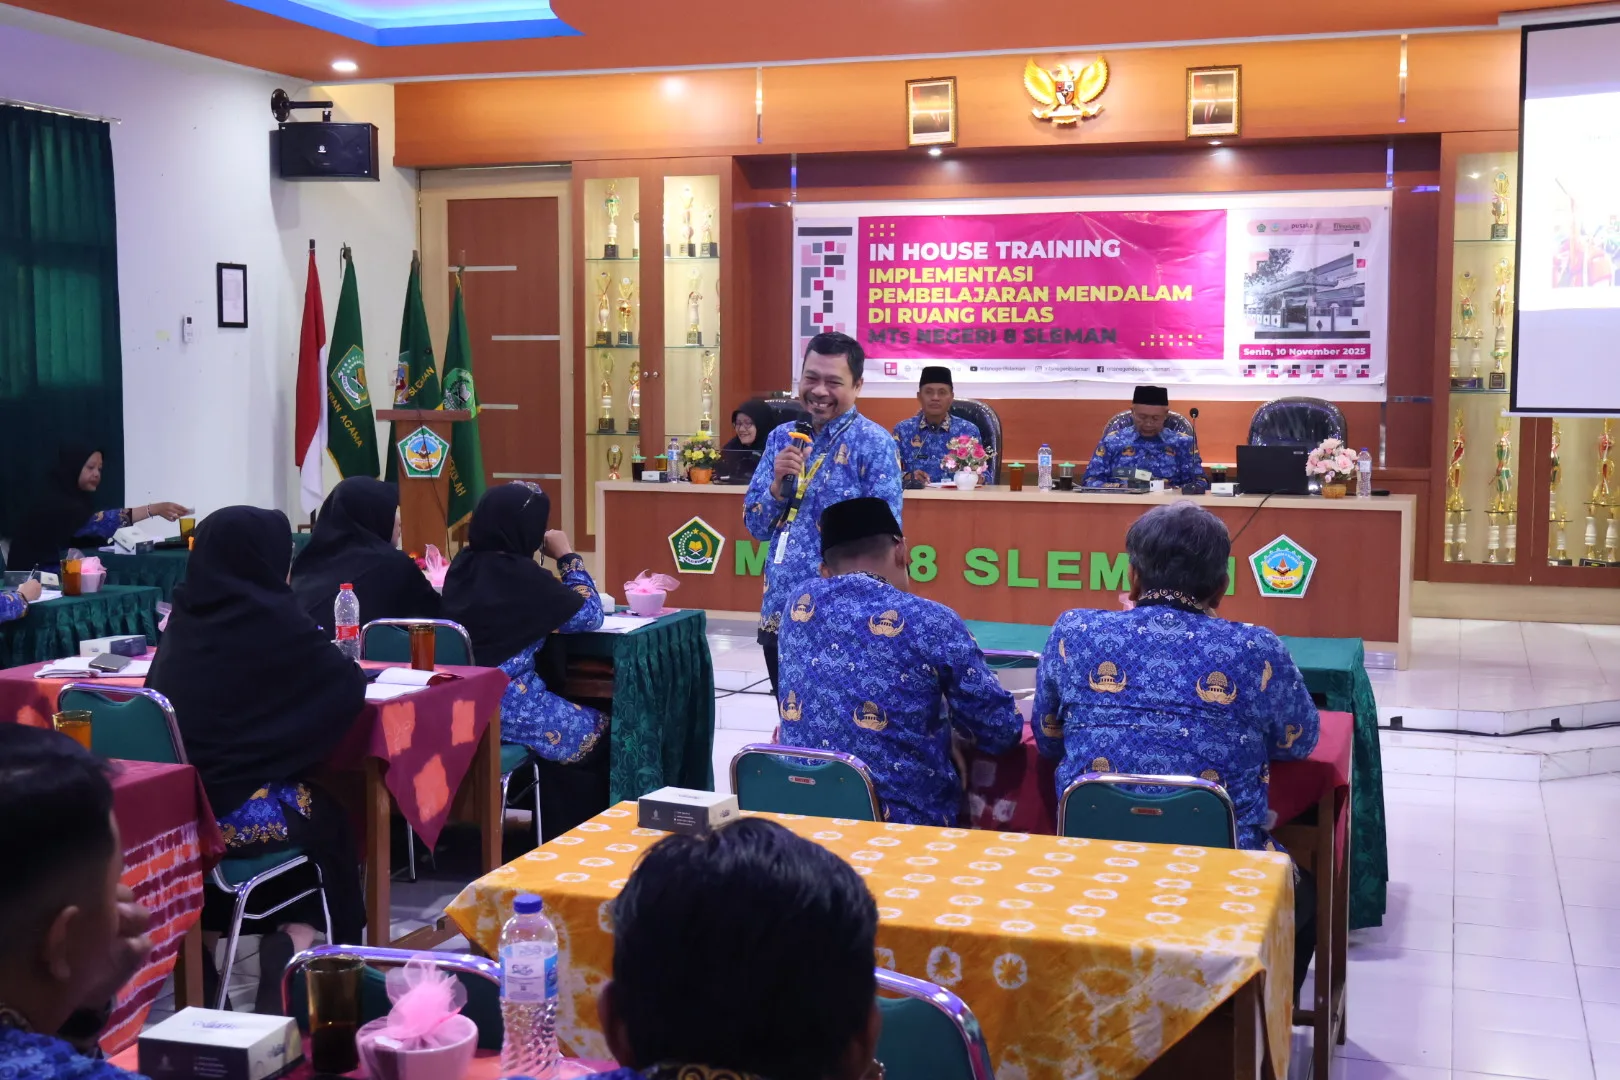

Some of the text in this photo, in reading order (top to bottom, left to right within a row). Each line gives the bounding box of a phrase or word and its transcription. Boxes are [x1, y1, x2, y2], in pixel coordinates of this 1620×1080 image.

[869, 239, 1121, 261] IN HOUSE TRAINING
[868, 265, 1033, 284] IMPLEMENTASI
[868, 284, 1193, 304] PEMBELAJARAN MENDALAM
[868, 306, 1055, 324] DI RUANG KELAS
[867, 326, 1117, 345] MTs NEGERI 8 SLEMAN
[1243, 347, 1367, 357] Senin, 10 November 2025
[340, 414, 364, 448] AGAMA
[909, 545, 938, 582] 8
